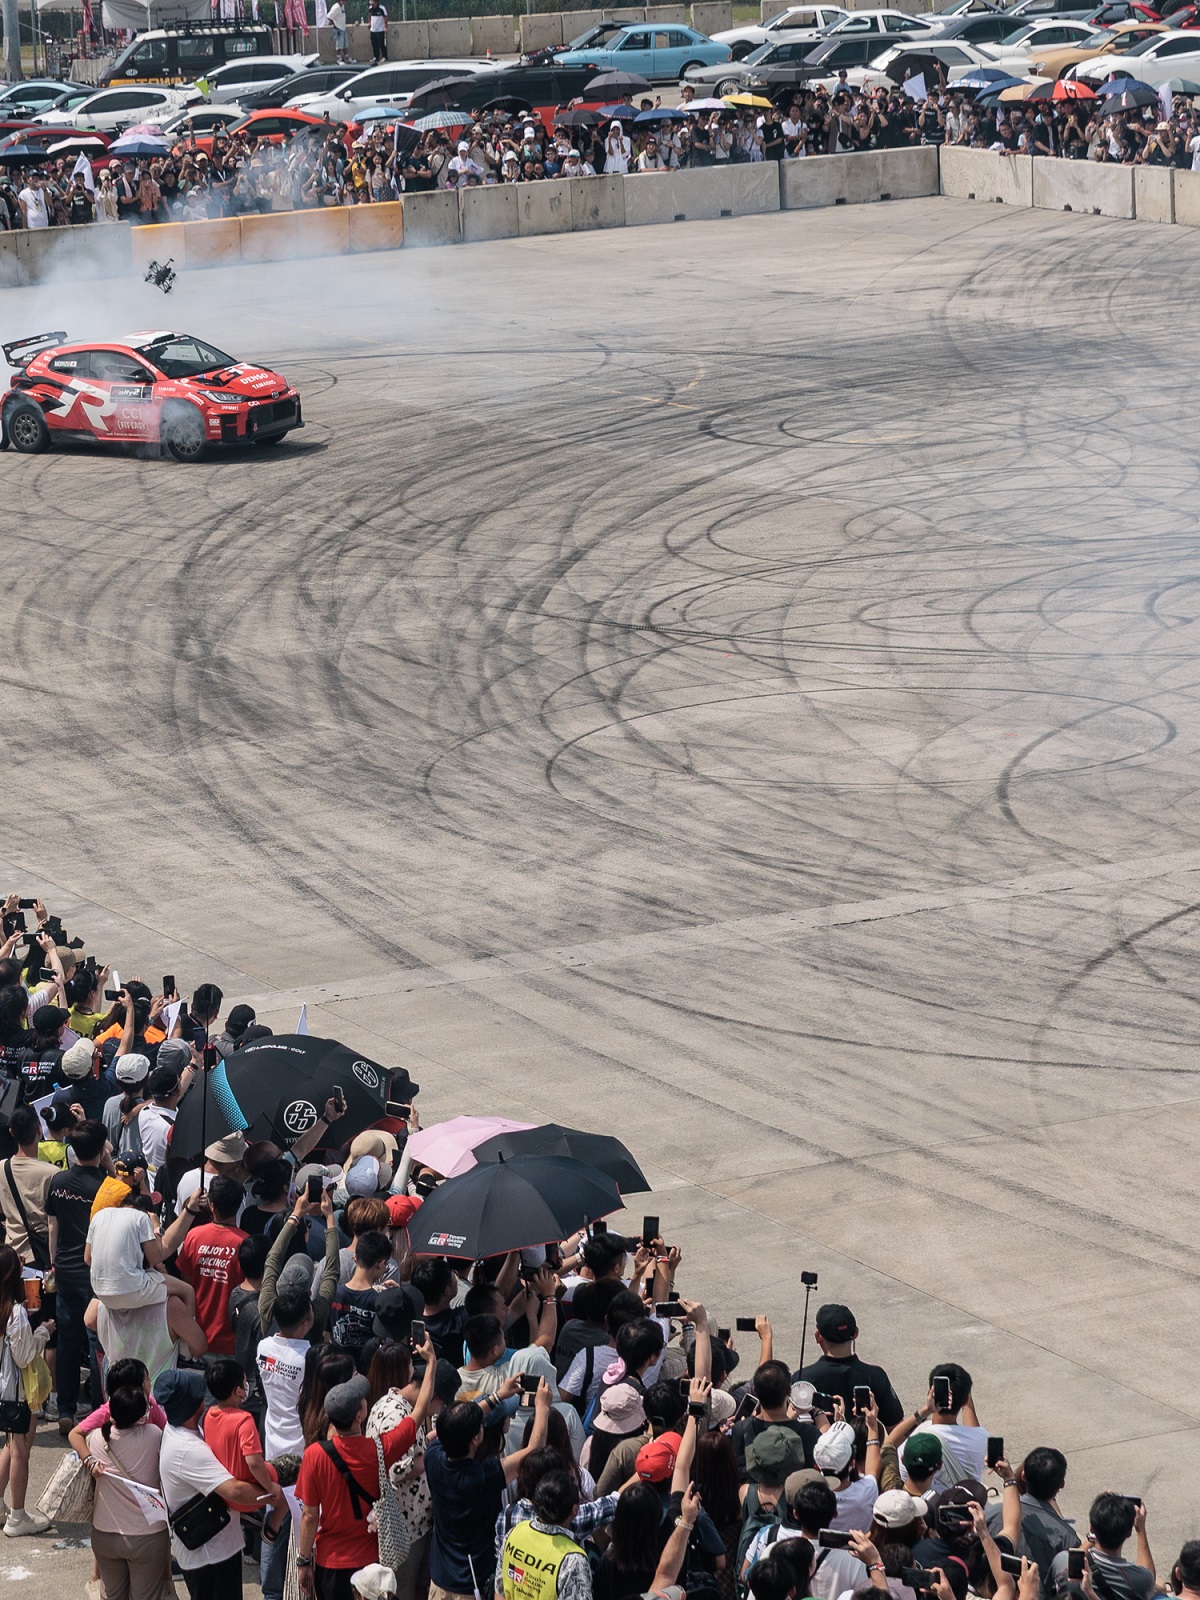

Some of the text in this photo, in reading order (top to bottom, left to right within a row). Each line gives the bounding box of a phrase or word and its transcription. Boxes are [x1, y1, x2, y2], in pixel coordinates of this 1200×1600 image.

[240, 373, 268, 385] DENSO
[22, 1064, 38, 1074] GR
[428, 1234, 446, 1245] GR
[197, 1245, 224, 1255] ENJOY
[198, 1257, 230, 1268] RACING!
[259, 1358, 275, 1373] GR
[505, 1541, 557, 1576] MEDIA
[507, 1566, 523, 1583] GR
